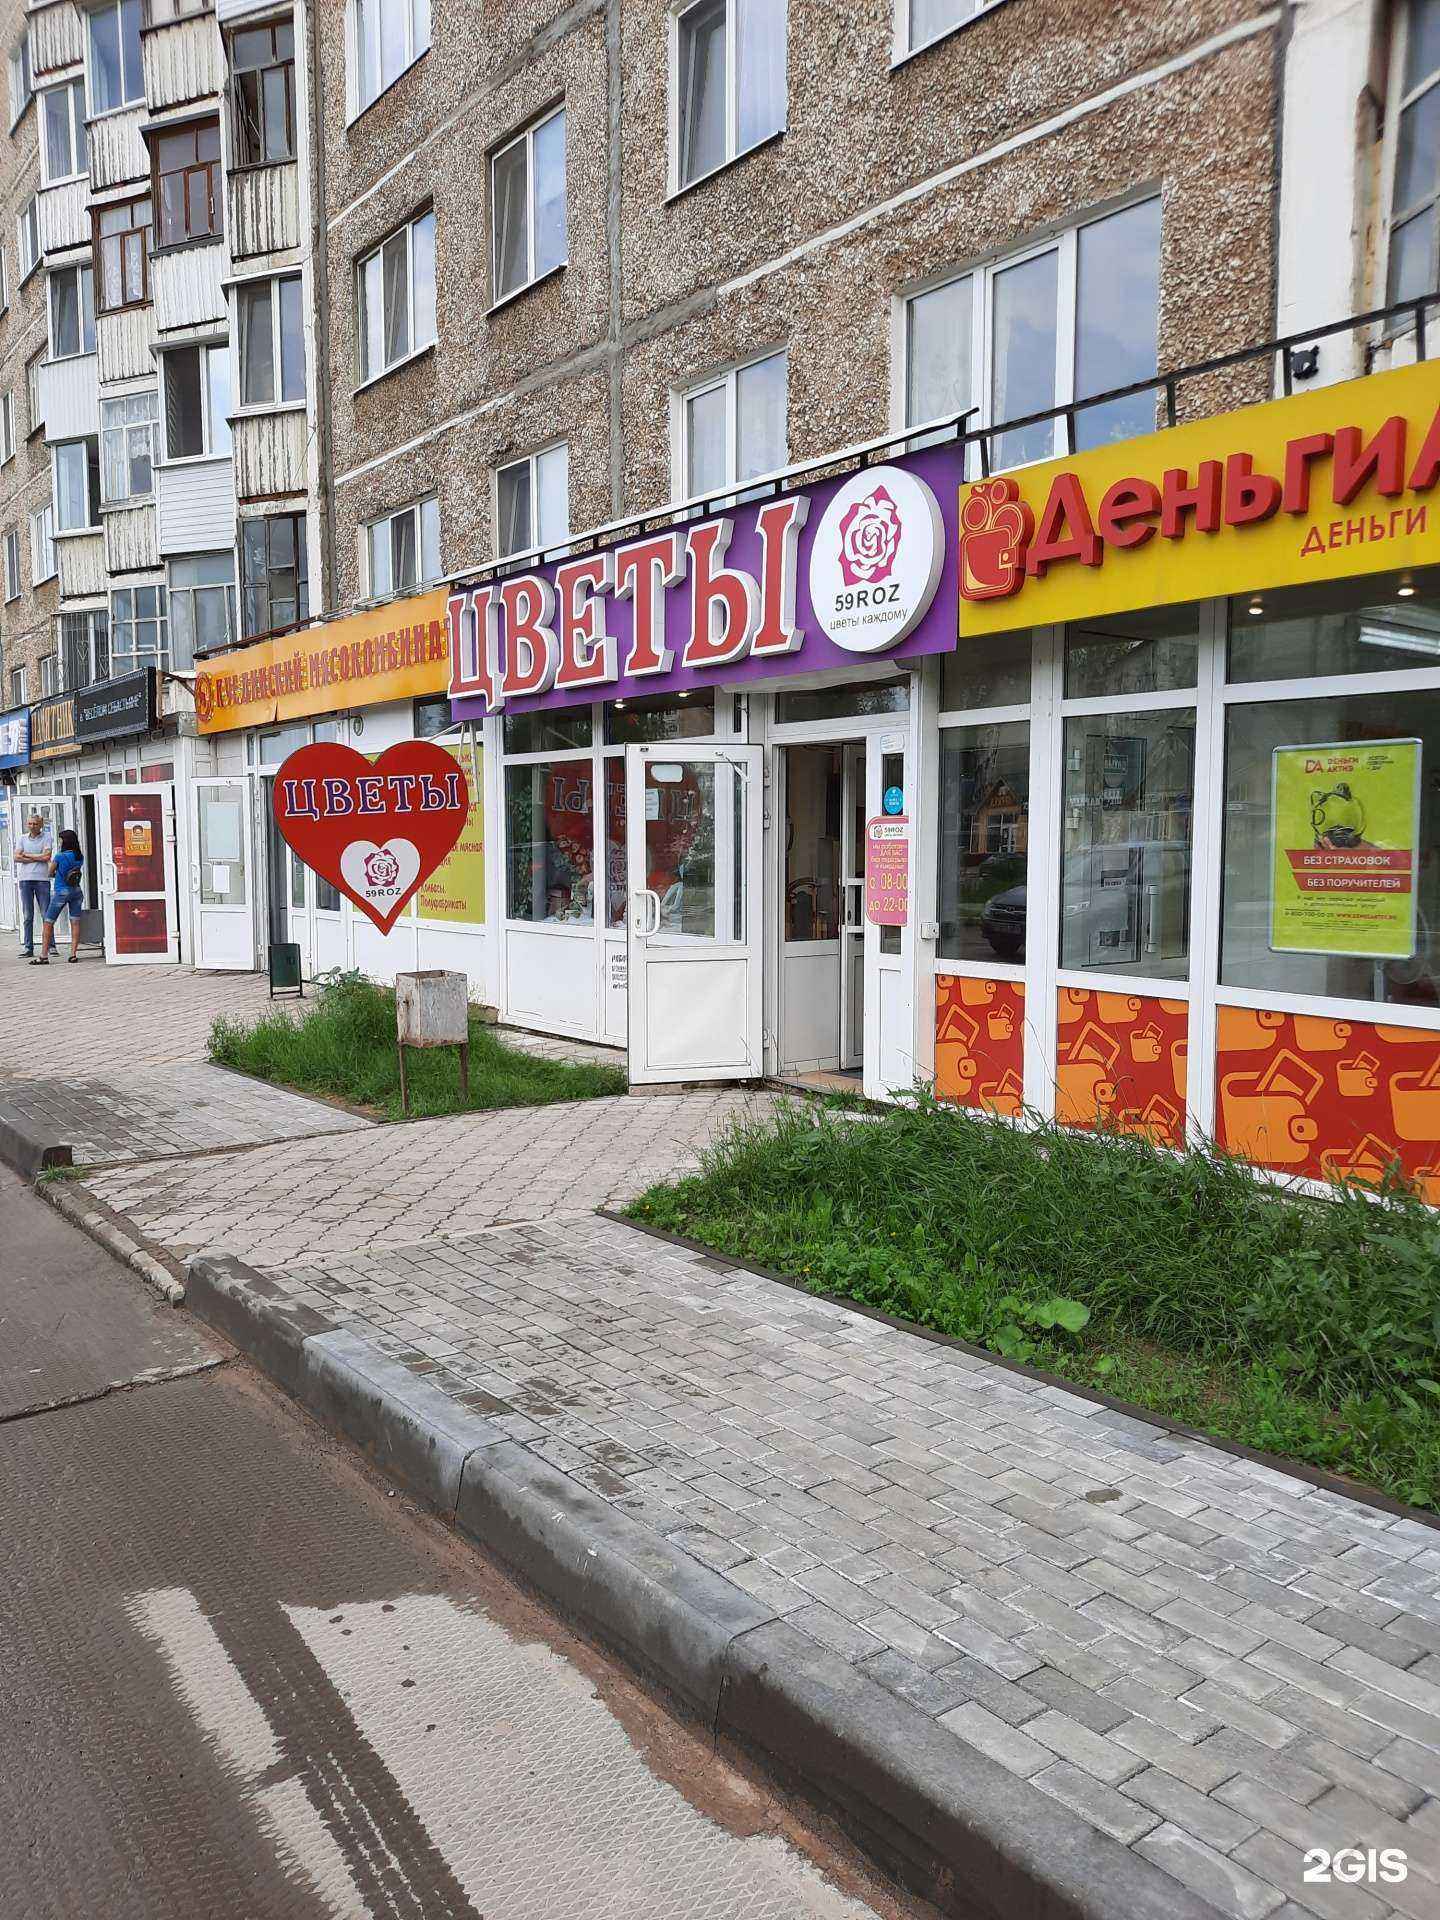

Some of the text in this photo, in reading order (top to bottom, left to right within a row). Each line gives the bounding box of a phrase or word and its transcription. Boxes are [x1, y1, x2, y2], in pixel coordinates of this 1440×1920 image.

[1300, 505, 1427, 557] ДЕНЬГИ
[447, 495, 811, 713] ЦВЕТЫ
[834, 583, 901, 612] 59ROZ
[829, 608, 908, 631] цветы каждому
[283, 773, 461, 822] ЦВЕТЫ
[1303, 855, 1391, 866] БЕЗ СТРАХОВОК
[365, 887, 402, 898] 59ROZ
[1307, 877, 1401, 889] БЕЗ ПОРУЧИТЕЛЕЙ
